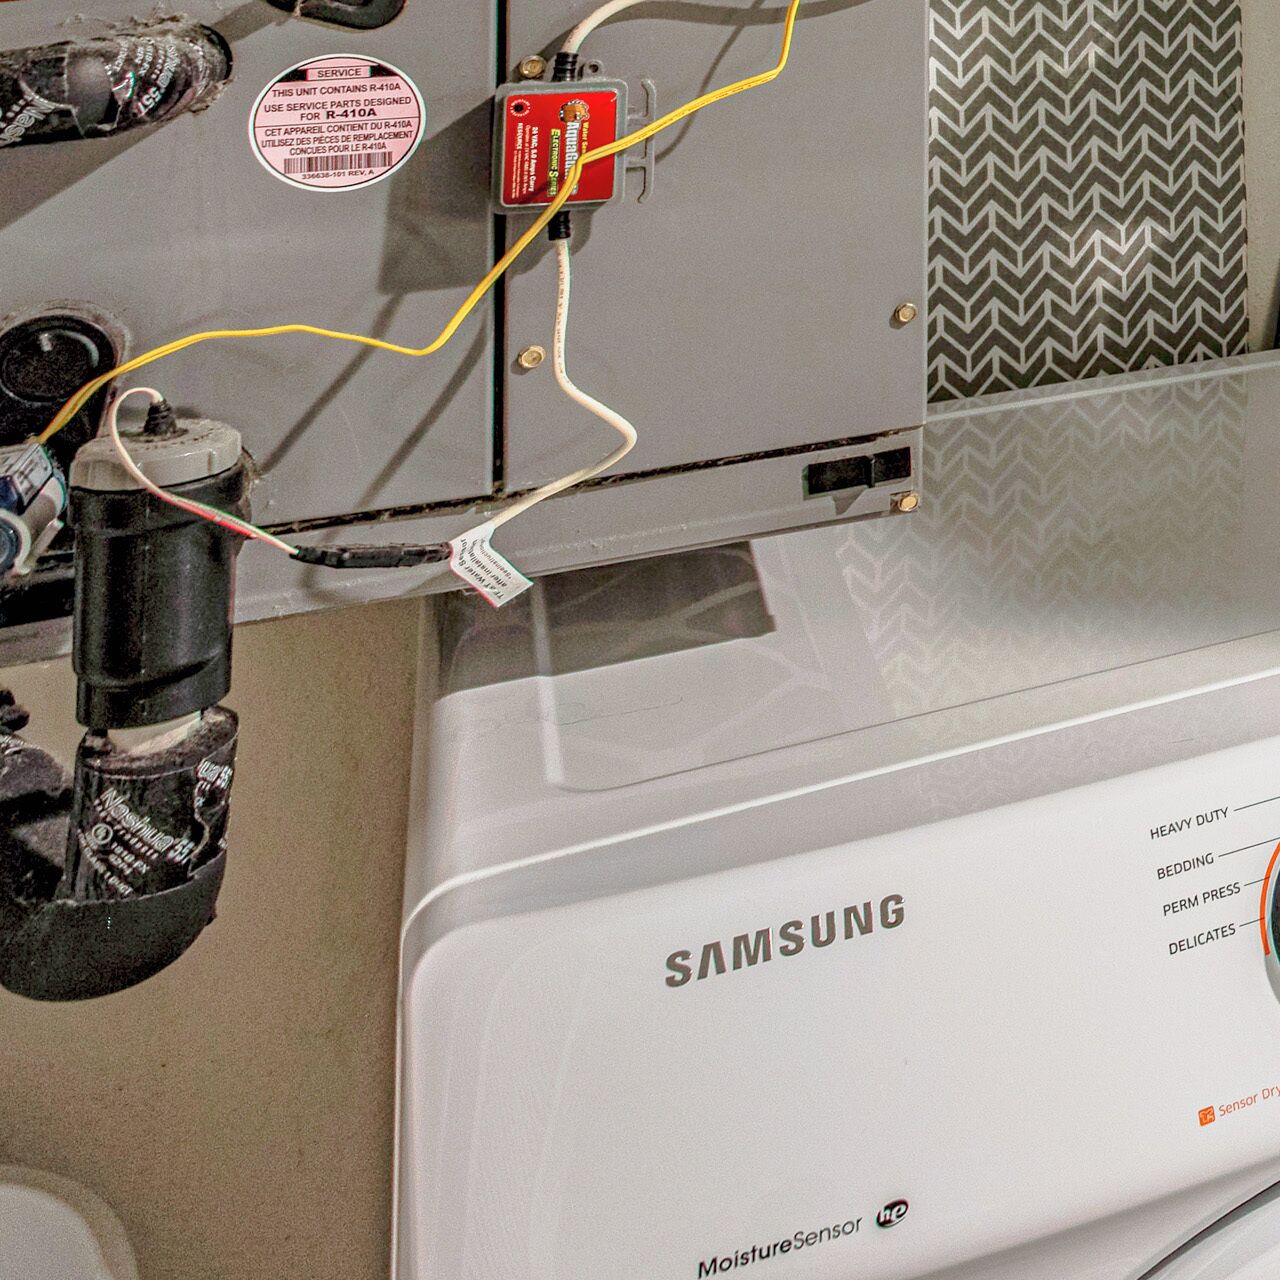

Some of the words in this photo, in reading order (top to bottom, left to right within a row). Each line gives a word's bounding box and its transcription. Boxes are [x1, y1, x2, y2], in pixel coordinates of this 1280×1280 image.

[317, 68, 361, 78] SERVICE
[272, 88, 294, 97] THIS
[295, 87, 318, 96] UNIT
[319, 84, 368, 95] CONTAINS
[369, 83, 401, 92] R-410A
[300, 112, 320, 120] FOR
[326, 108, 377, 119] R-410A
[550, 128, 561, 171] ELECTRONIC
[100, 787, 175, 853] Nashua
[1150, 817, 1192, 840] HEAVY
[1196, 807, 1228, 826] DUTY
[1157, 852, 1214, 880] BEDDING
[1163, 895, 1199, 916] PERM
[1202, 882, 1240, 904] PRESS
[665, 894, 904, 988] SAMSUNG
[1169, 923, 1236, 955] DELICATES
[1218, 1093, 1258, 1117] Sensor
